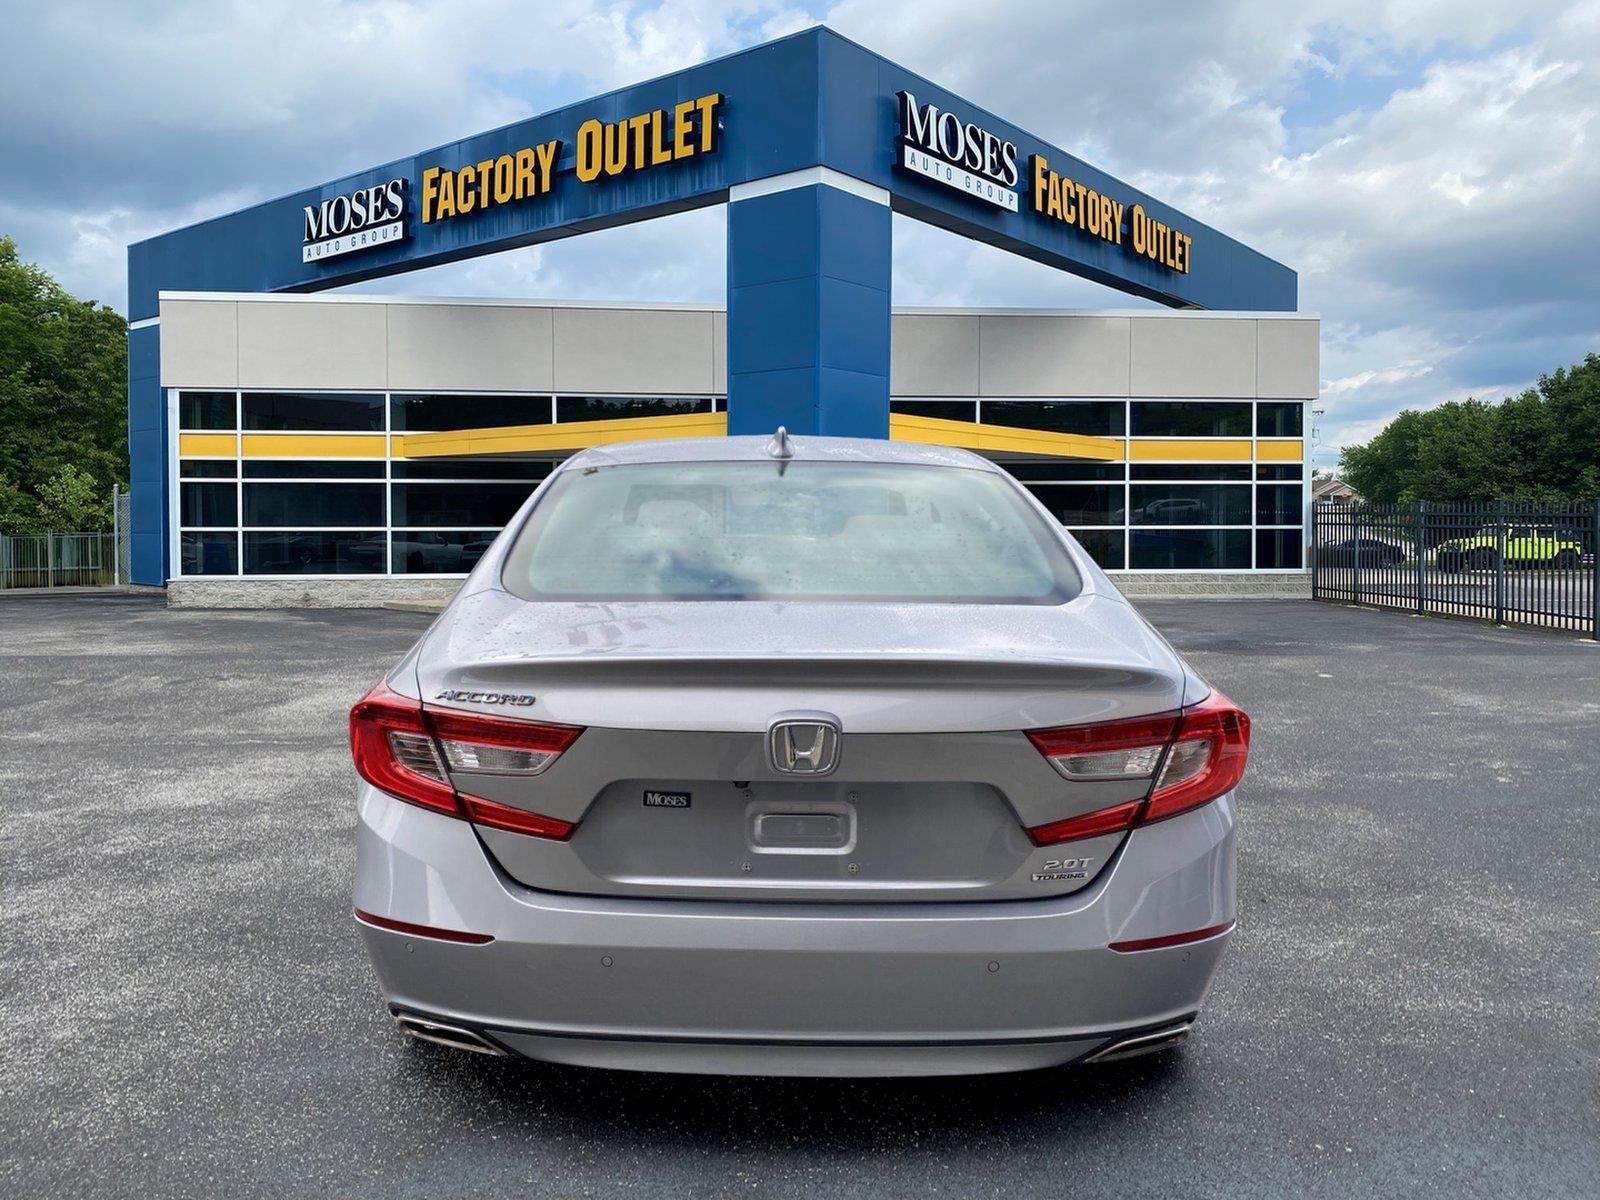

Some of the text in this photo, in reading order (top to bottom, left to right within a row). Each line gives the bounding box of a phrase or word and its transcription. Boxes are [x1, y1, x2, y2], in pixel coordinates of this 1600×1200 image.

[422, 93, 720, 224] FACTORY OUTLET
[904, 90, 1018, 187] MOSES
[909, 152, 1015, 206] AUTO GROUP
[303, 179, 404, 242] MOSES
[1034, 154, 1192, 274] FACTORY OUTLET
[306, 225, 400, 260] AUTO GROUP
[434, 688, 536, 707] ACCORD
[645, 792, 688, 808] MOSES
[1035, 871, 1087, 881] TOURING
